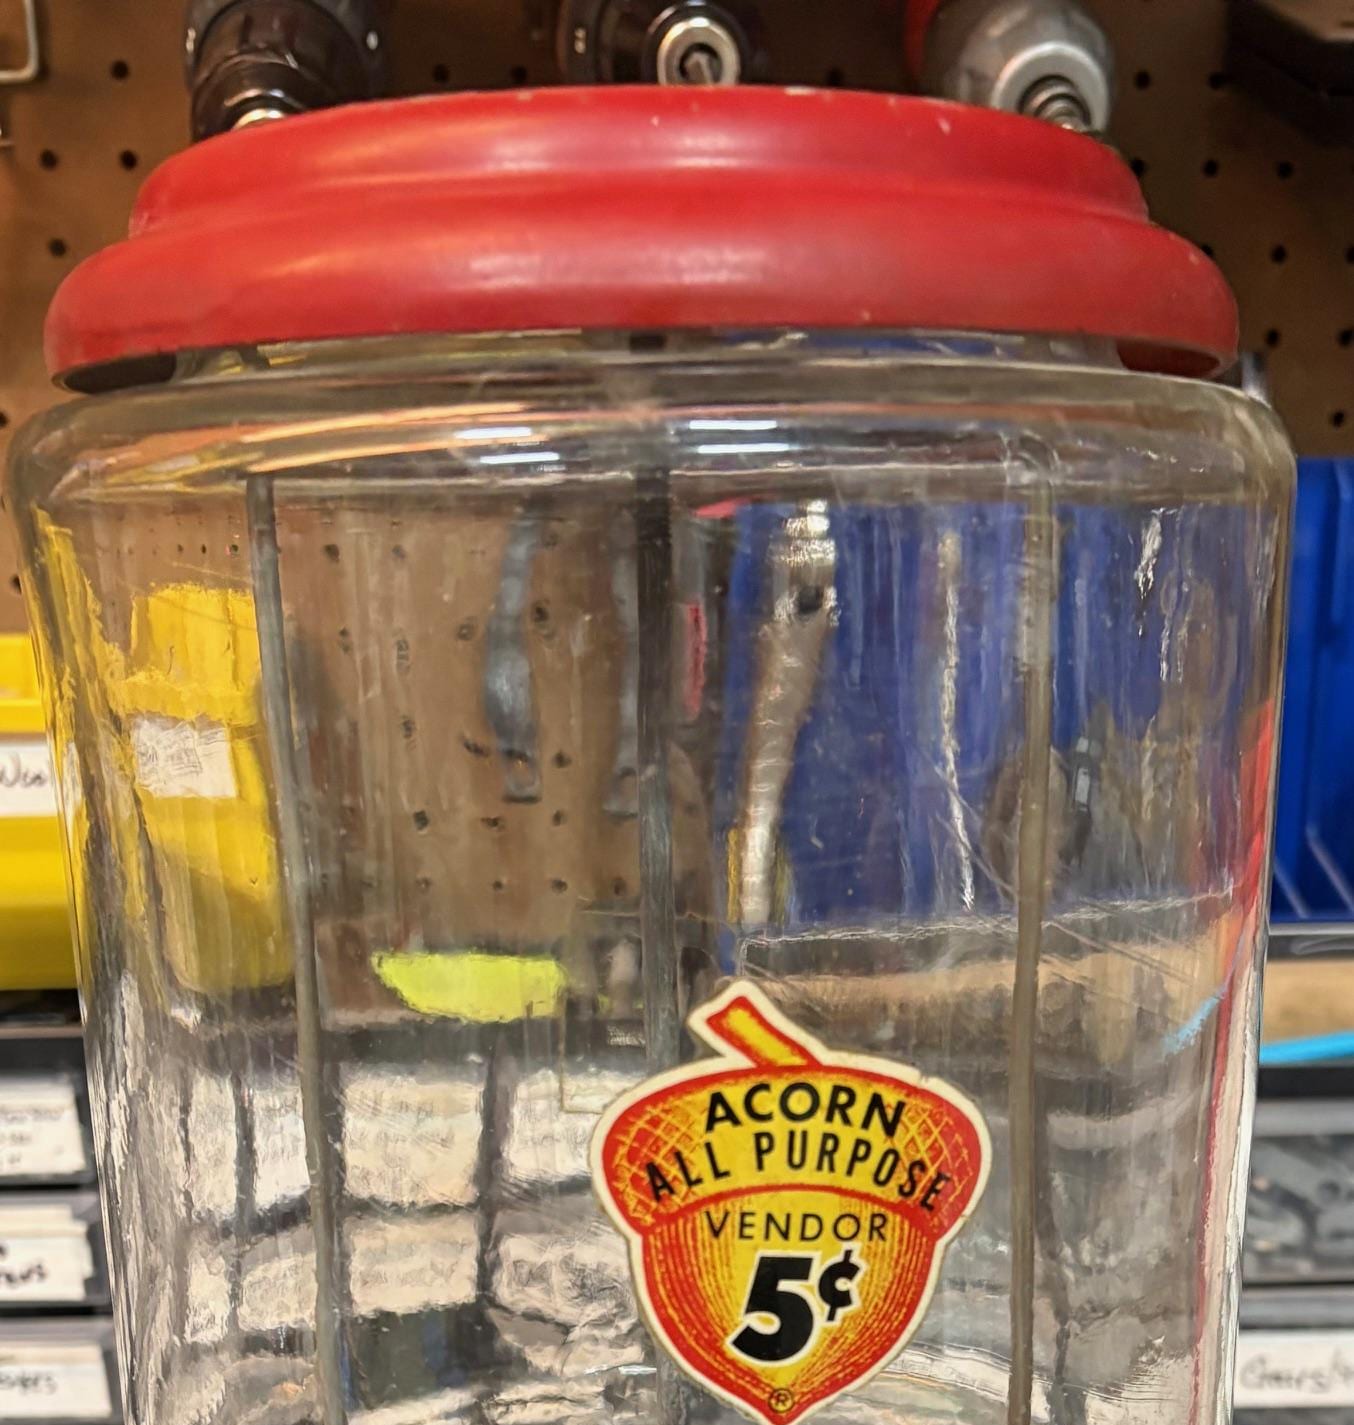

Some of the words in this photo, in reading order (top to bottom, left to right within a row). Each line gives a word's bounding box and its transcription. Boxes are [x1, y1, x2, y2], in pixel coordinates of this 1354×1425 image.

[705, 1082, 907, 1138] ACORN
[645, 1140, 732, 1202] ALL
[754, 1129, 952, 1212] PURPOSE
[705, 1211, 888, 1242] VENDOR
[731, 1249, 861, 1362] 5¢
